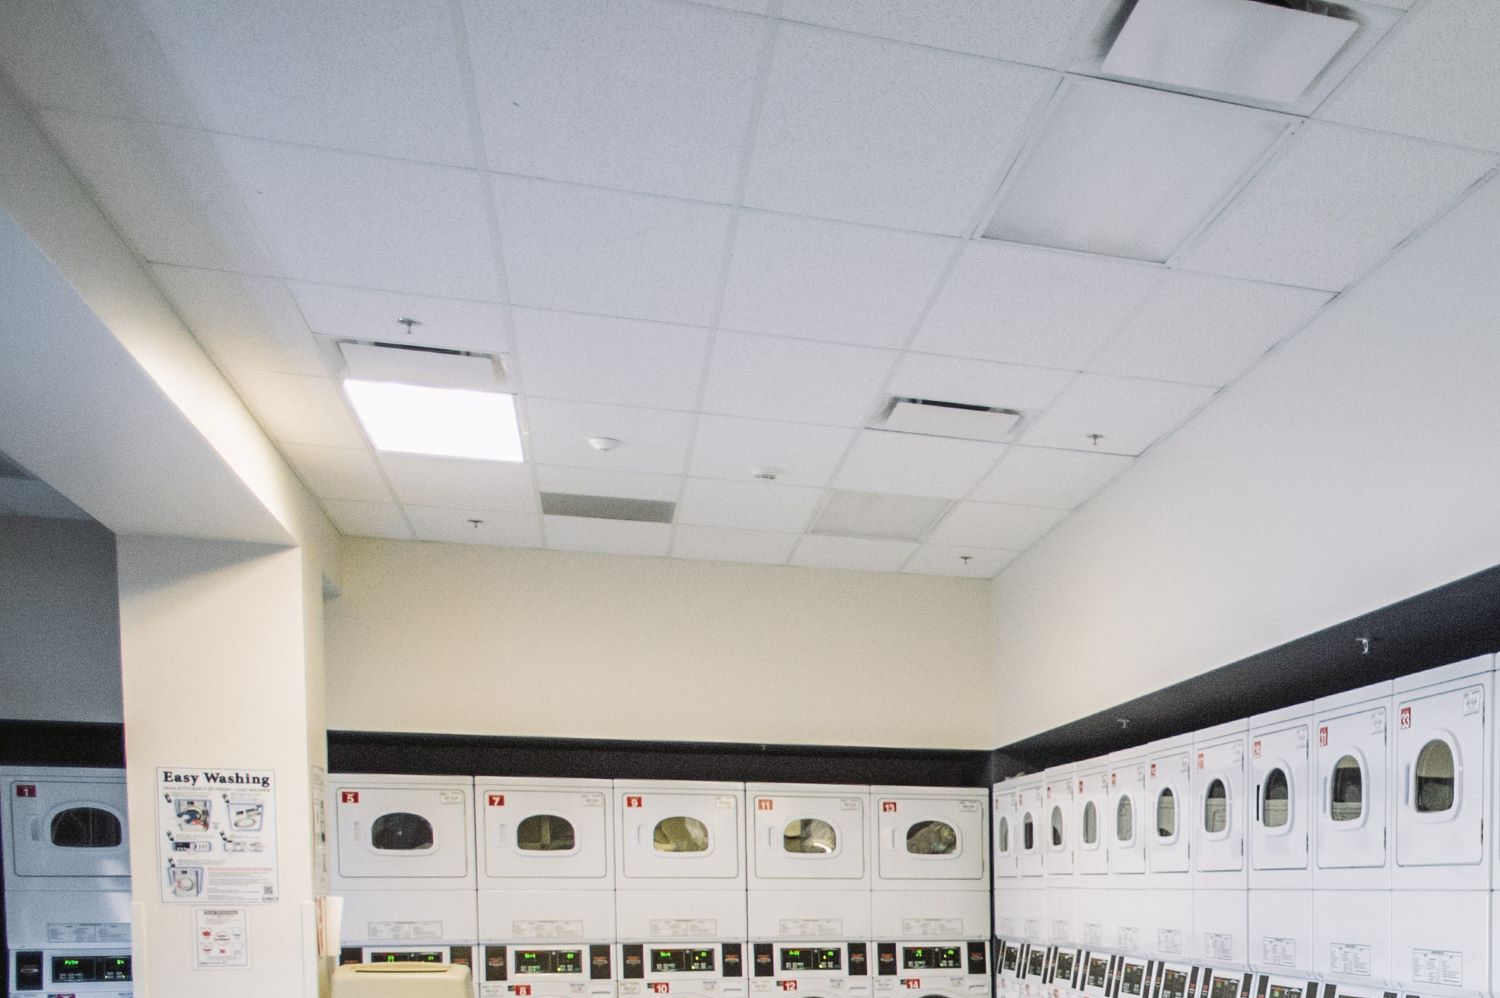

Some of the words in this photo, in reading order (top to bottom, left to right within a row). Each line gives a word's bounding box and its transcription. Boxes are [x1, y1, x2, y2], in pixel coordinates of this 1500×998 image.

[162, 771, 199, 786] Easy
[204, 772, 270, 788] Washing
[656, 985, 668, 993] 10
[785, 982, 795, 990] 12
[908, 981, 918, 989] 14
